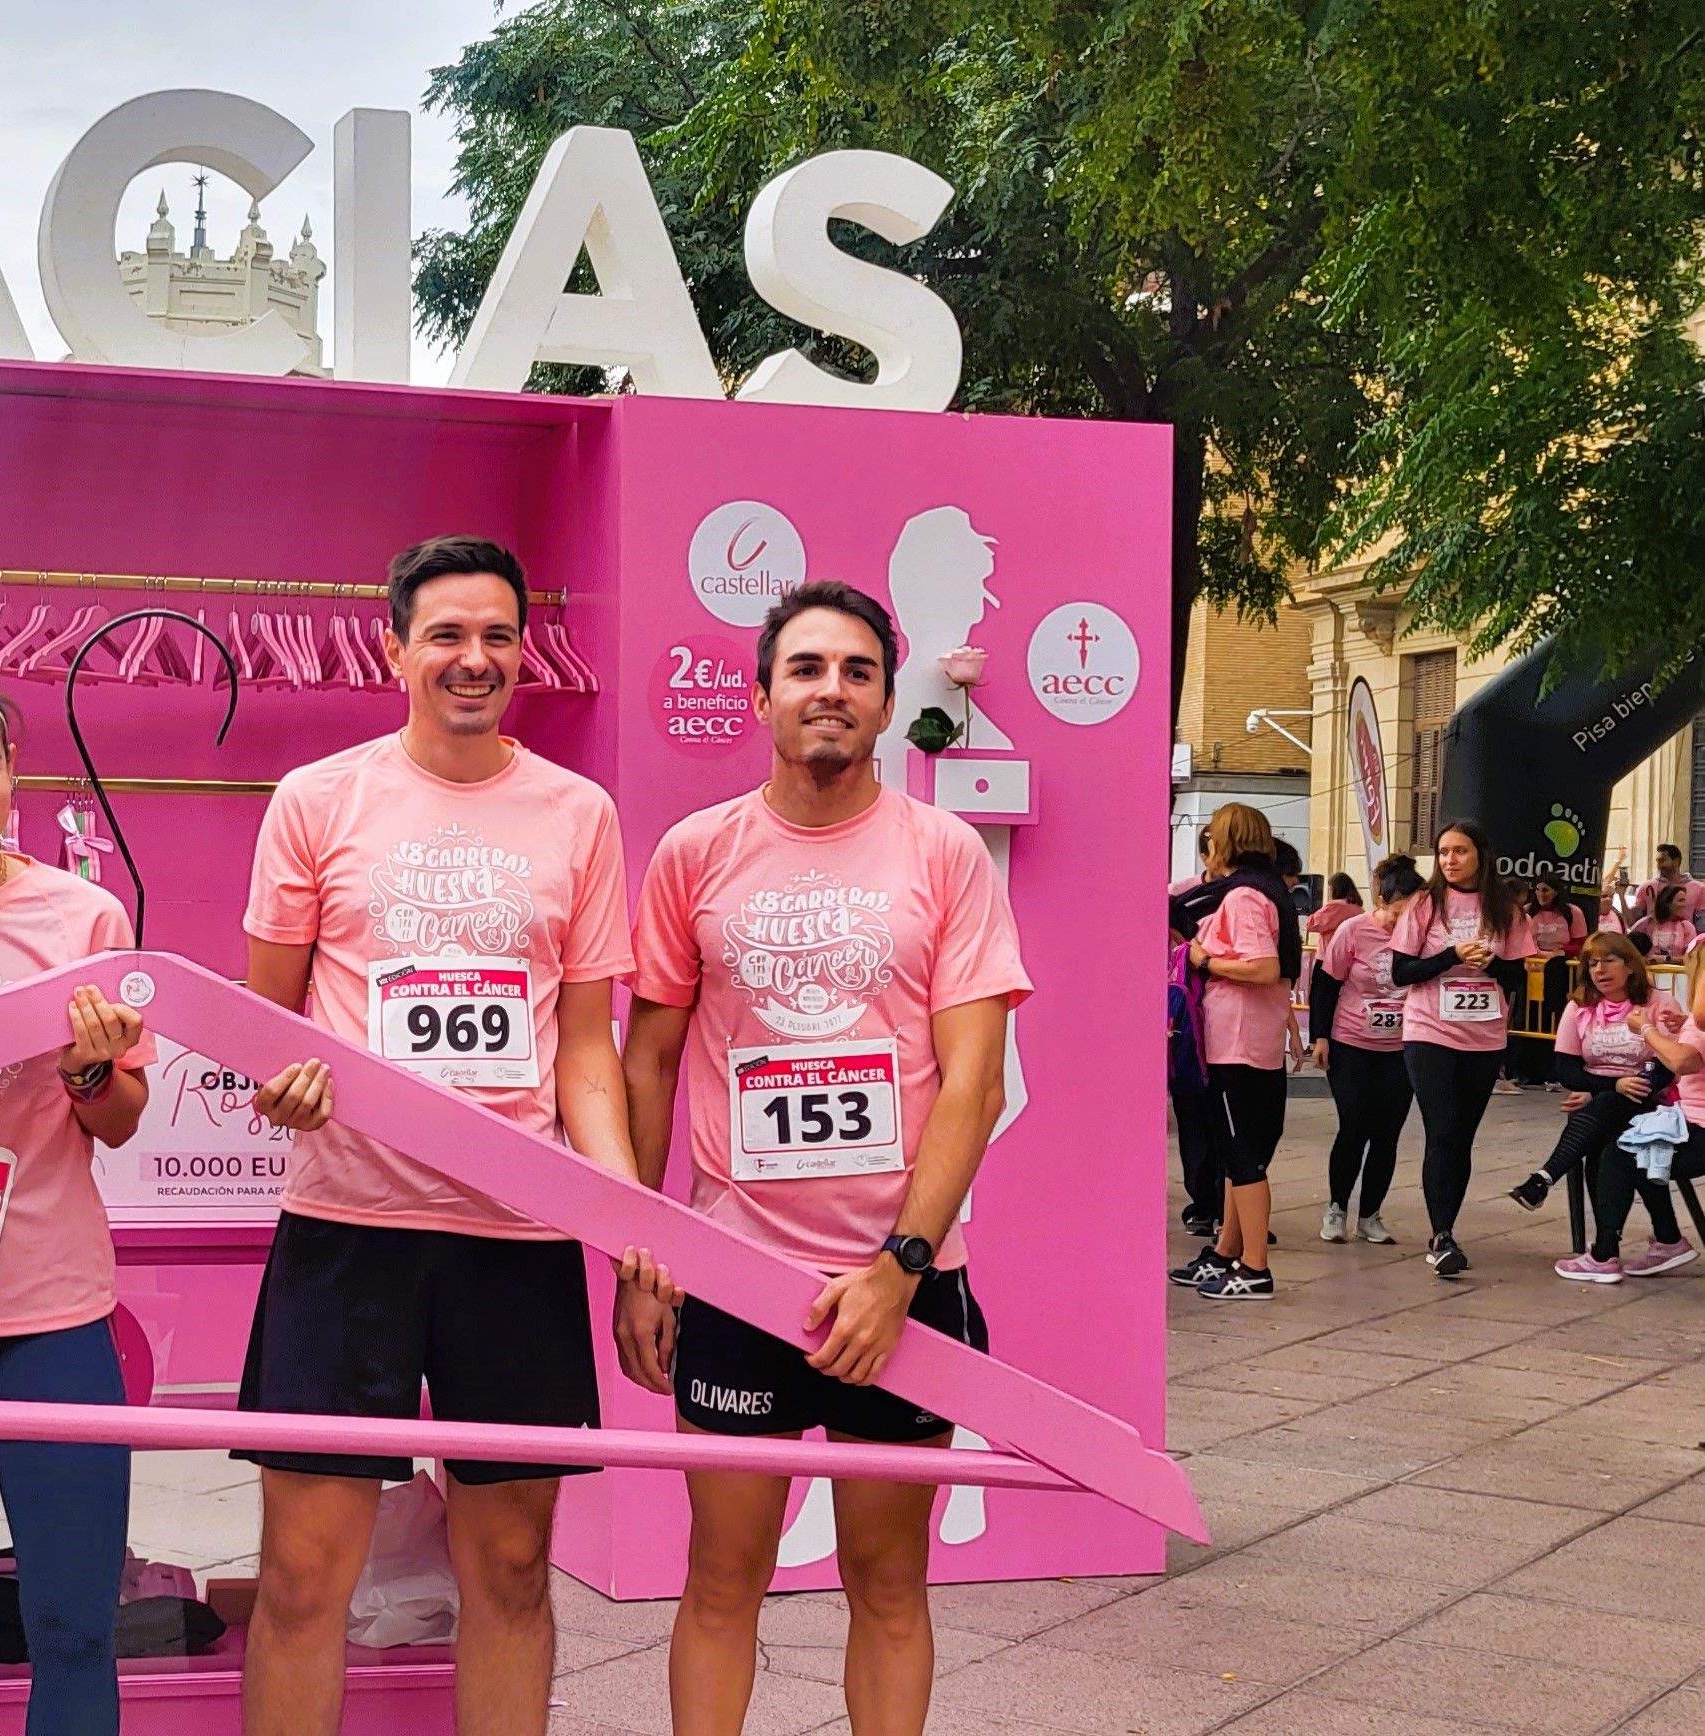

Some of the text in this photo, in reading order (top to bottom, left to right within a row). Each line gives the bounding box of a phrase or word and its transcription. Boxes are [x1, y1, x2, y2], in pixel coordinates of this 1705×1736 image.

[669, 646, 748, 690] 2€/ud.
[1042, 674, 1125, 696] aecc
[663, 694, 748, 710] a beneficio
[668, 716, 744, 736] aecc
[1572, 716, 1615, 752] Pisa
[439, 972, 481, 982] HUESCA
[390, 980, 521, 997] CONTRA EL CÁNCER
[1454, 994, 1490, 1010] 223
[407, 1004, 510, 1052] 969
[1371, 1013, 1403, 1027] 287
[791, 1060, 835, 1072] HUESCA
[746, 1068, 886, 1088] CONTRA EL CÁNCER
[763, 1091, 872, 1144] 153
[154, 1157, 243, 1177] 10.000
[157, 1186, 235, 1196] RECAUDACIÓN
[237, 1187, 264, 1196] PARA
[691, 1379, 773, 1415] OLIVARES
